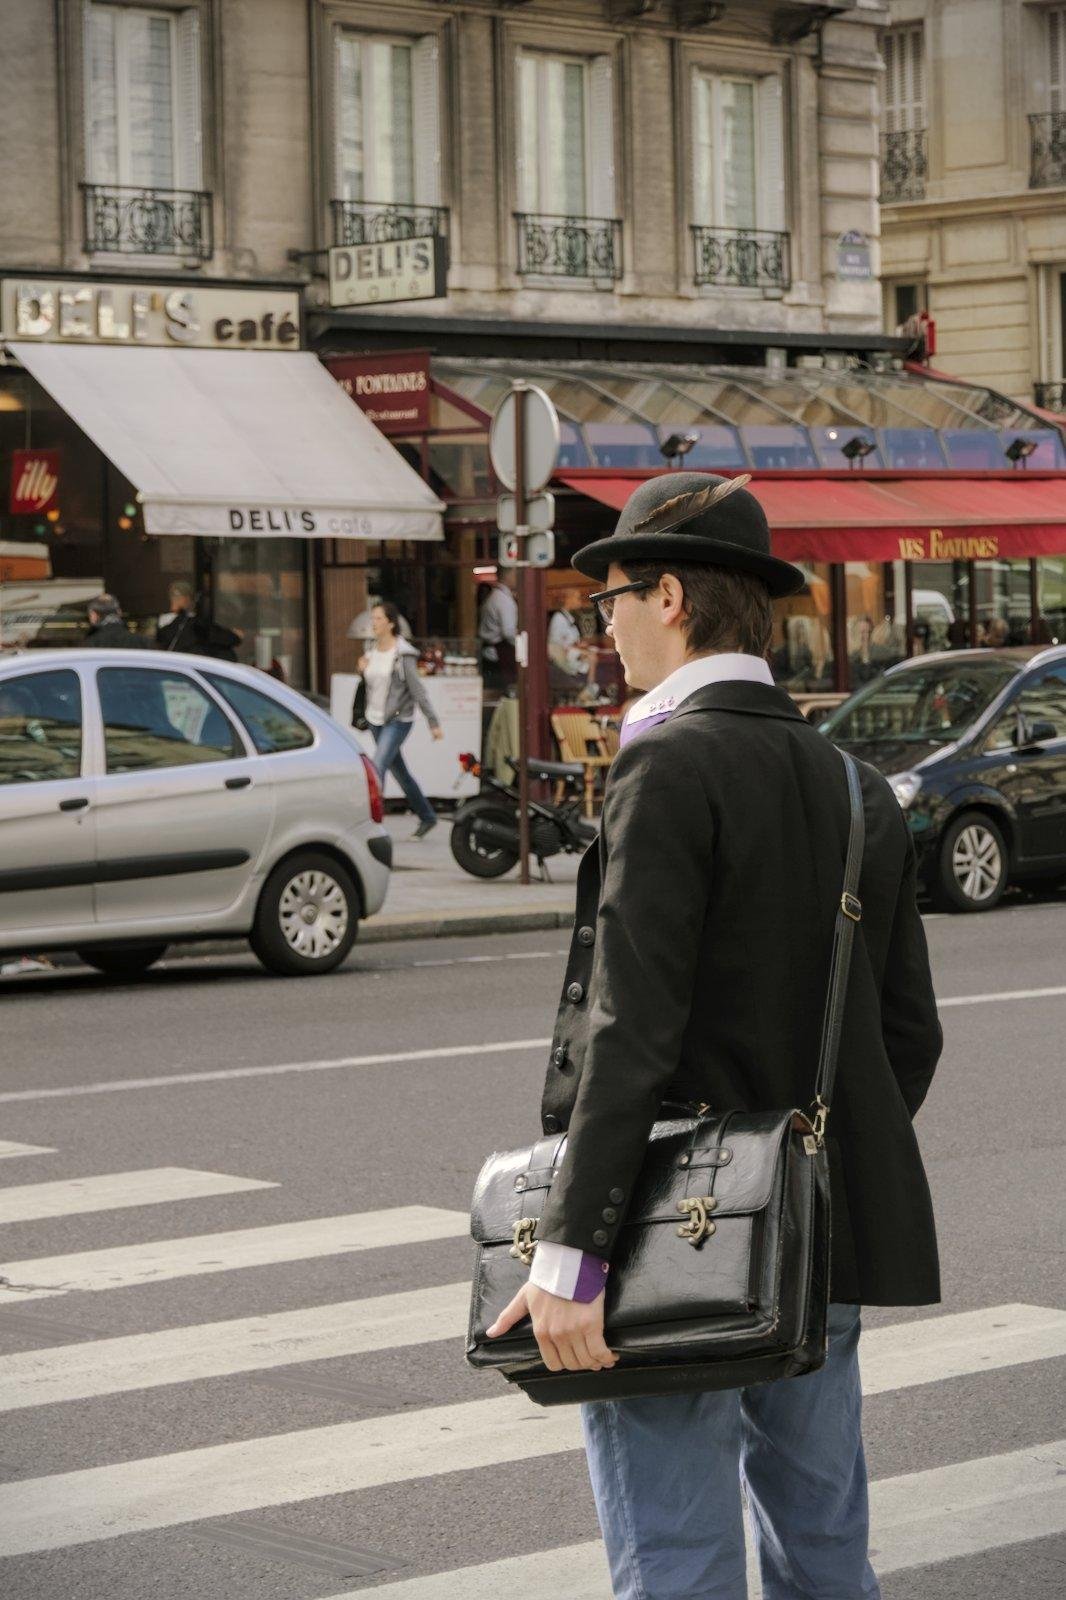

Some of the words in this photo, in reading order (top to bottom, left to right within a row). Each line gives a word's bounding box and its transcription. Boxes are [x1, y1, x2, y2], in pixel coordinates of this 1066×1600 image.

[334, 243, 431, 280] DELI'S
[15, 286, 200, 342] DELI'S
[213, 311, 299, 344] café
[355, 371, 426, 395] FONTAINES
[15, 458, 58, 508] illy
[229, 509, 316, 532] DELI'S
